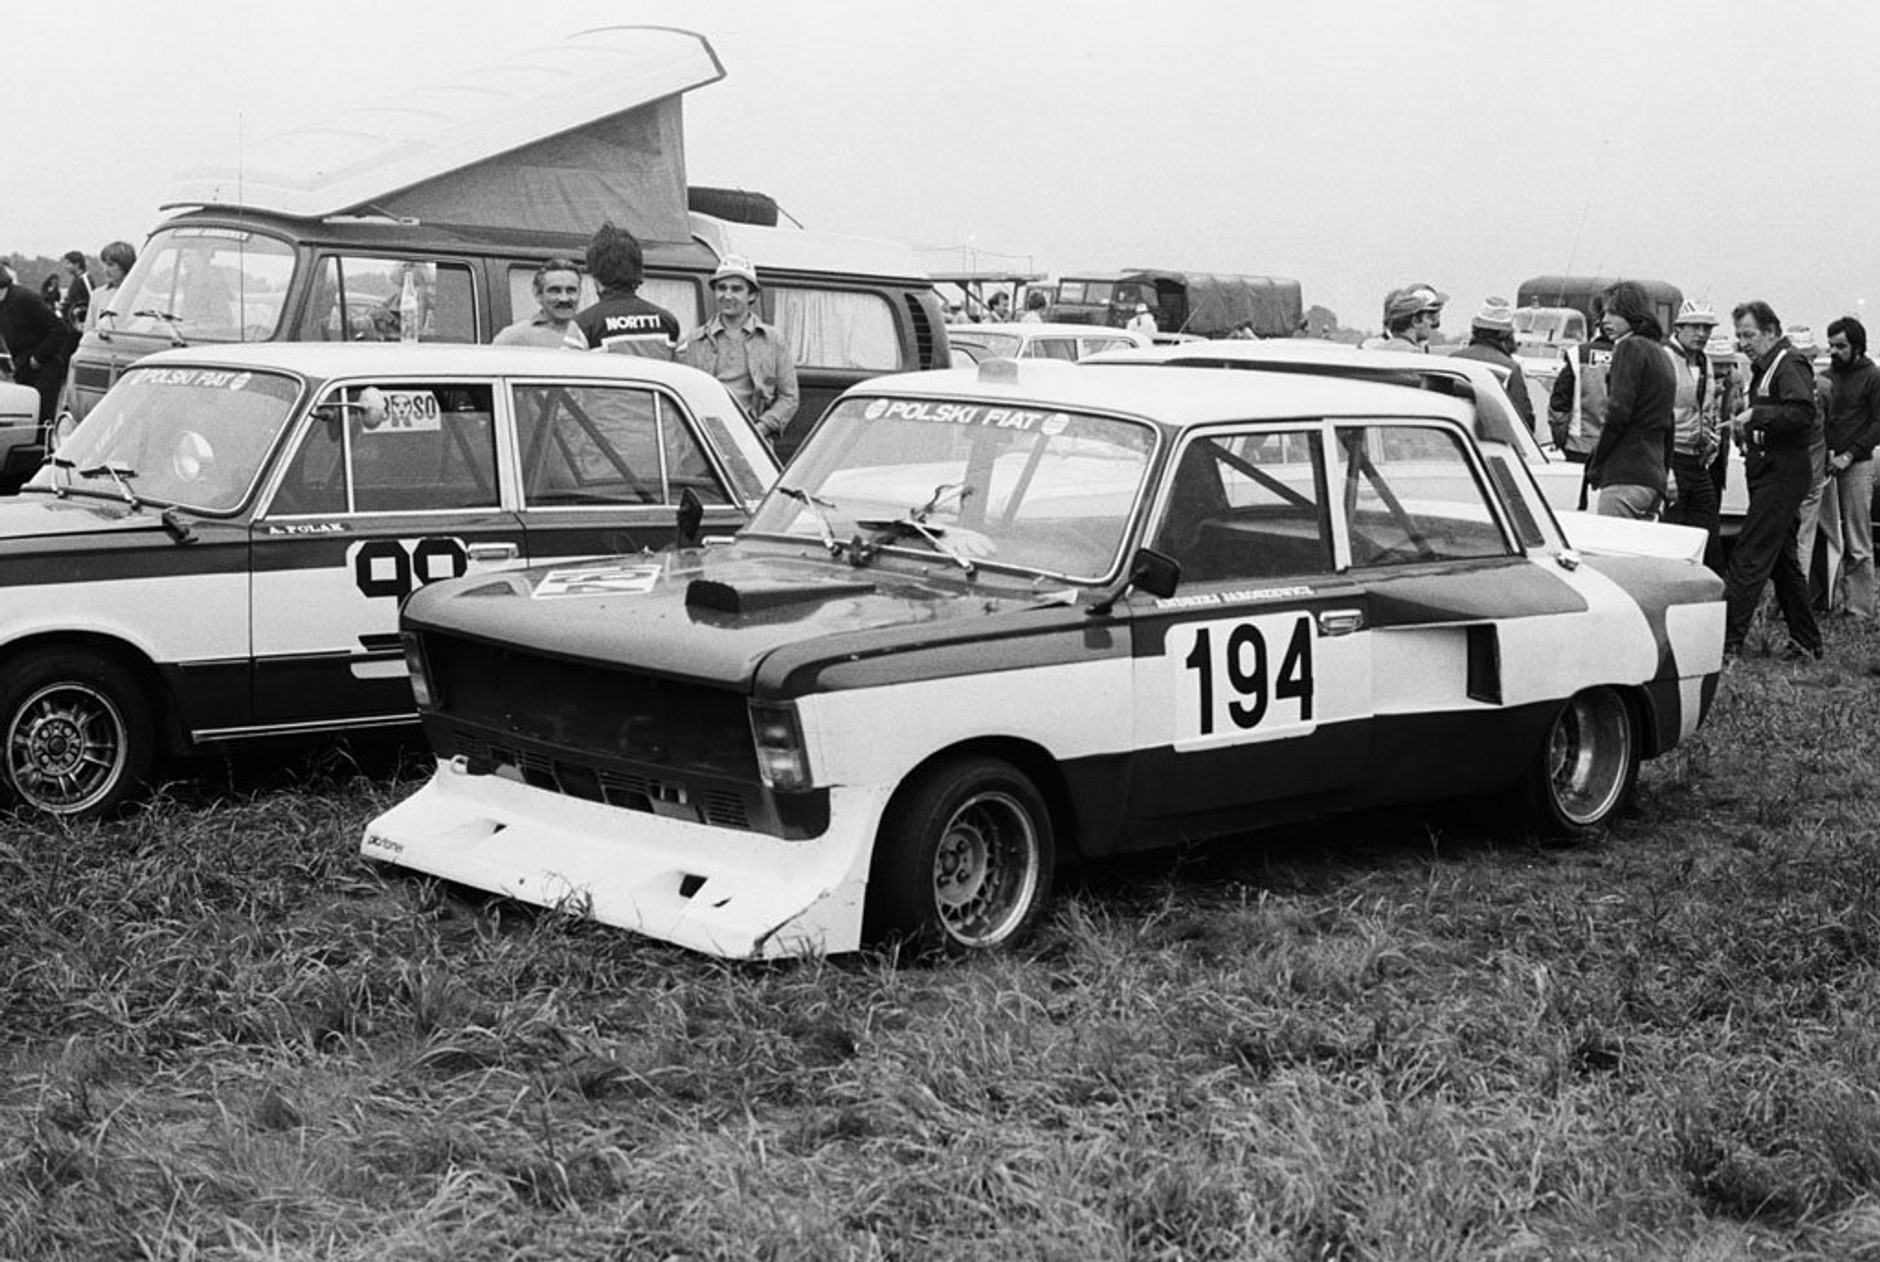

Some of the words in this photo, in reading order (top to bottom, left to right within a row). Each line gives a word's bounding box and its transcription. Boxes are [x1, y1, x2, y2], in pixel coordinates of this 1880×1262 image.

[605, 314, 660, 331] NORTTI
[885, 402, 978, 424] POLSKI
[982, 409, 1041, 430] FIAT
[286, 523, 344, 534] POLAK
[1186, 617, 1313, 735] 194
